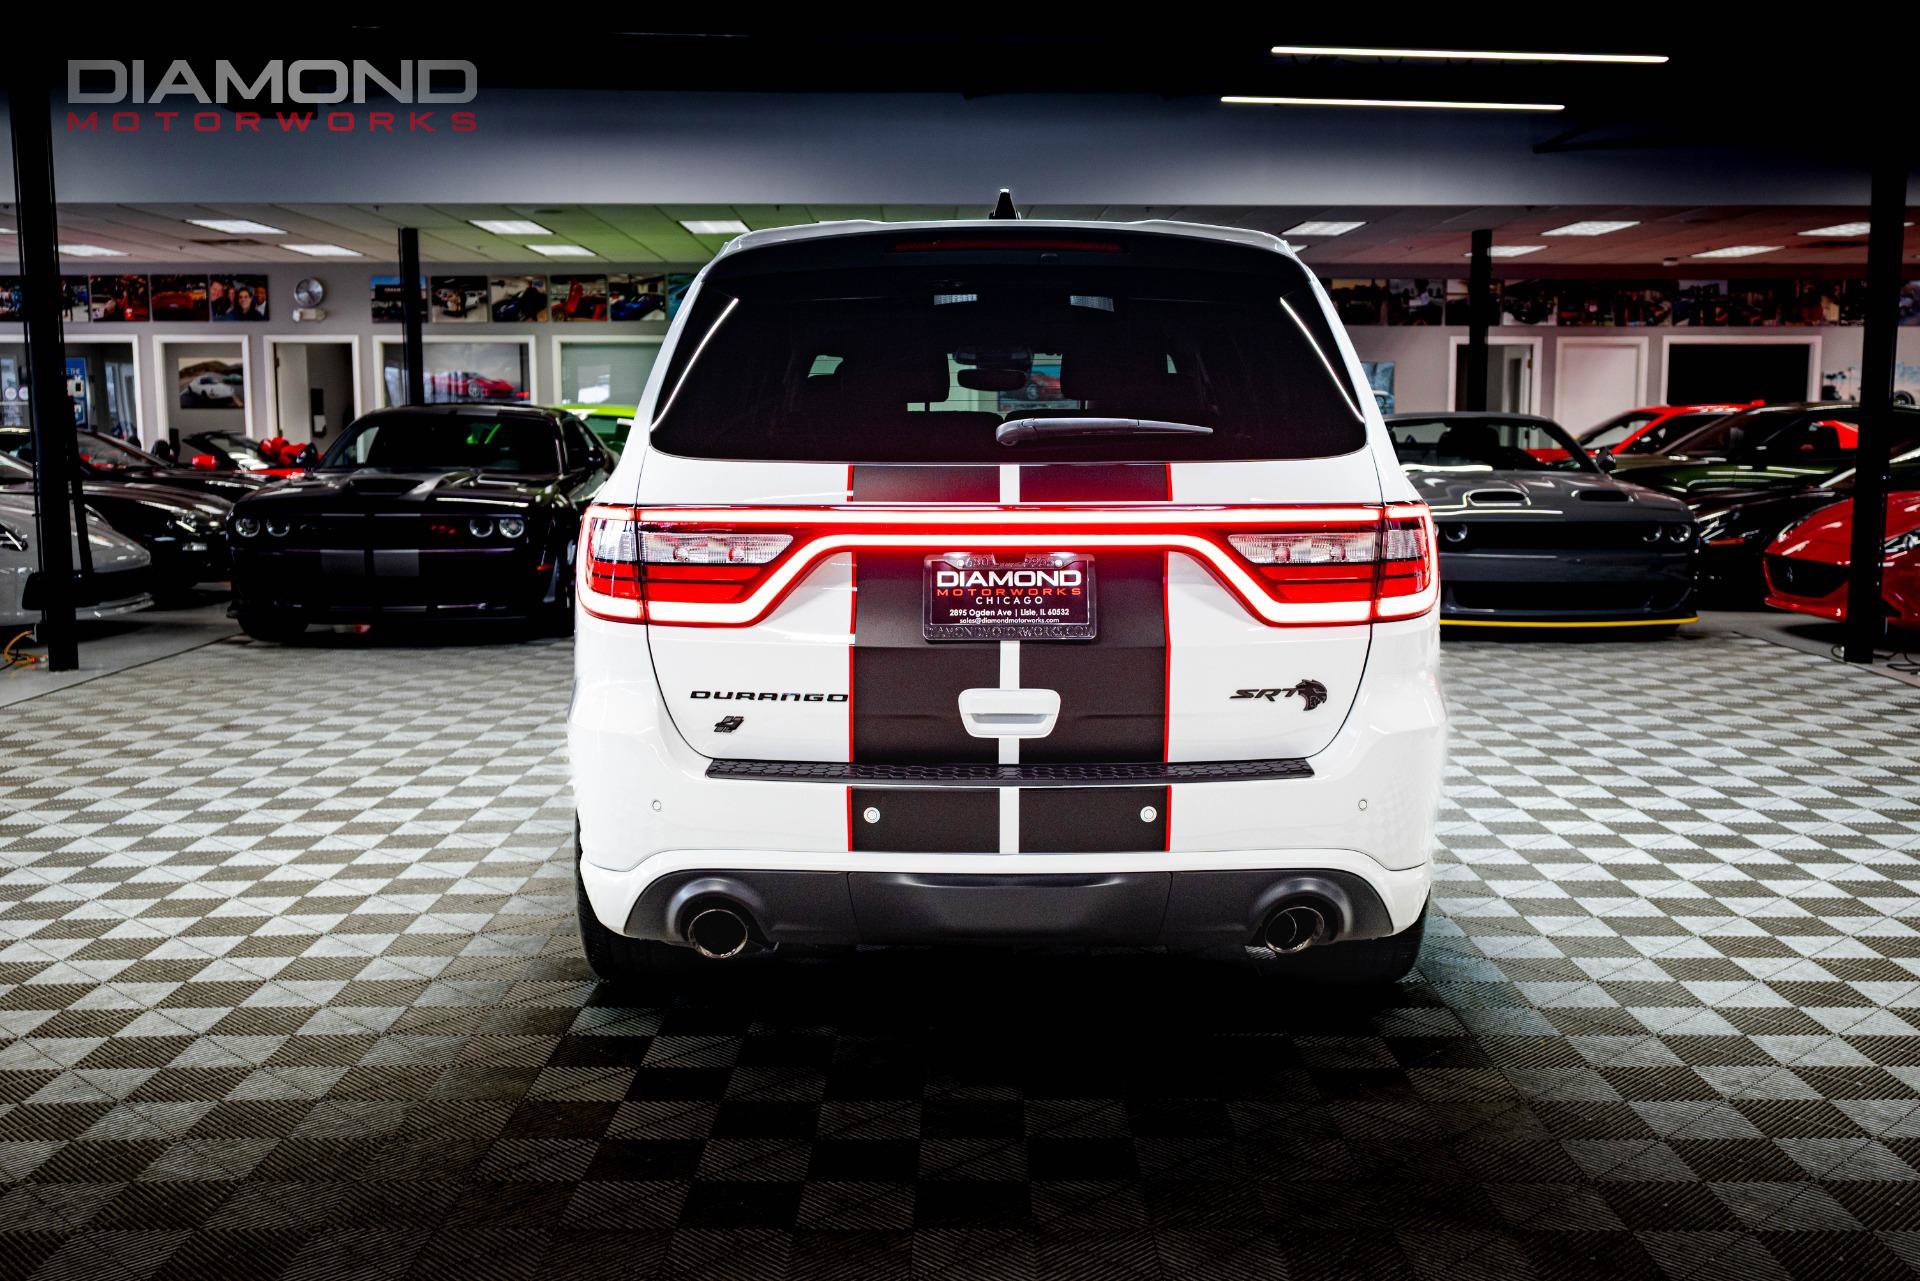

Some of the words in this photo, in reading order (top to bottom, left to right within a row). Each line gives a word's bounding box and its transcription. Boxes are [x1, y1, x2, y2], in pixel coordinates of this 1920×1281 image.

[936, 570, 1082, 587] DIAMOND
[937, 588, 1081, 597] MOTORWORKS
[976, 596, 1043, 605] CHICAGO
[950, 609, 967, 617] 2895
[968, 609, 995, 618] Ogden
[997, 609, 1012, 617] Ave
[1047, 608, 1070, 616] 60532
[690, 690, 849, 702] DURANGO
[1229, 687, 1299, 702] SRT
